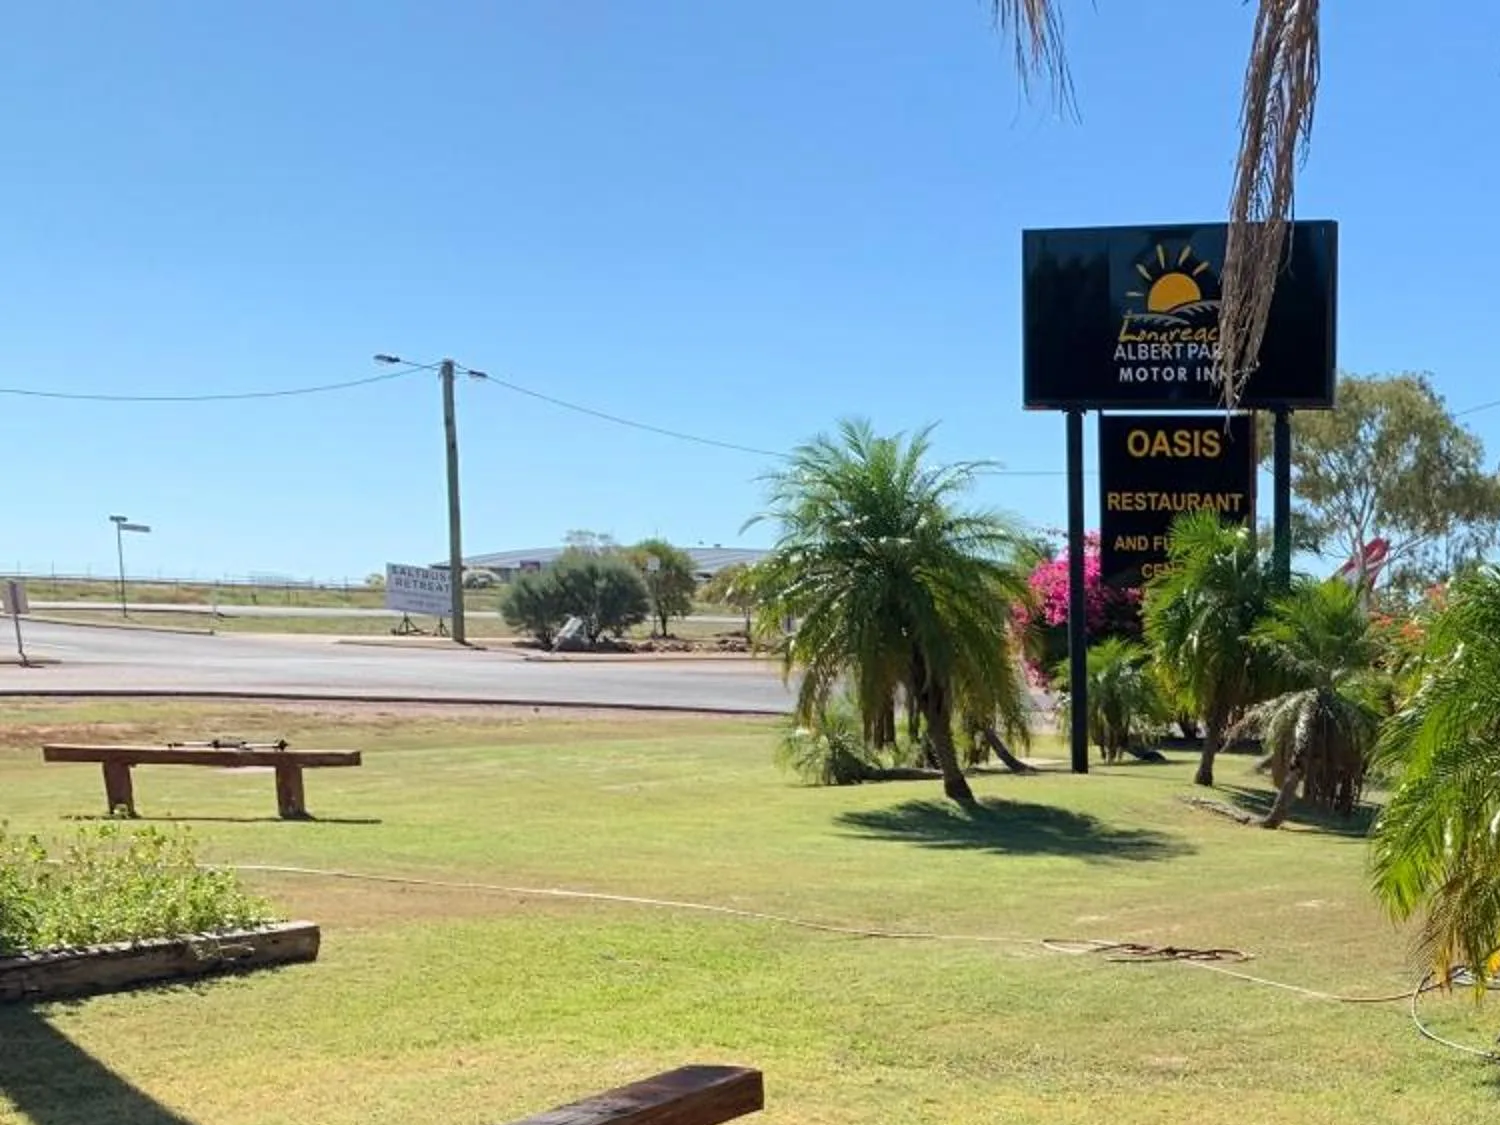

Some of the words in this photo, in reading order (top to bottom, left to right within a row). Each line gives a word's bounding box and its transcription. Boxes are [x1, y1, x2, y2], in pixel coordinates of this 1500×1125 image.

[1119, 309, 1220, 343] Longreac
[1114, 343, 1184, 361] ALBERT
[1188, 342, 1222, 361] PAR
[1119, 367, 1187, 382] MOTOR
[1127, 429, 1222, 458] OASIS
[1107, 492, 1244, 512] RESTAURANT
[1113, 535, 1149, 552] AND
[391, 564, 453, 583] SALTBUS
[395, 577, 449, 594] RETREAT
